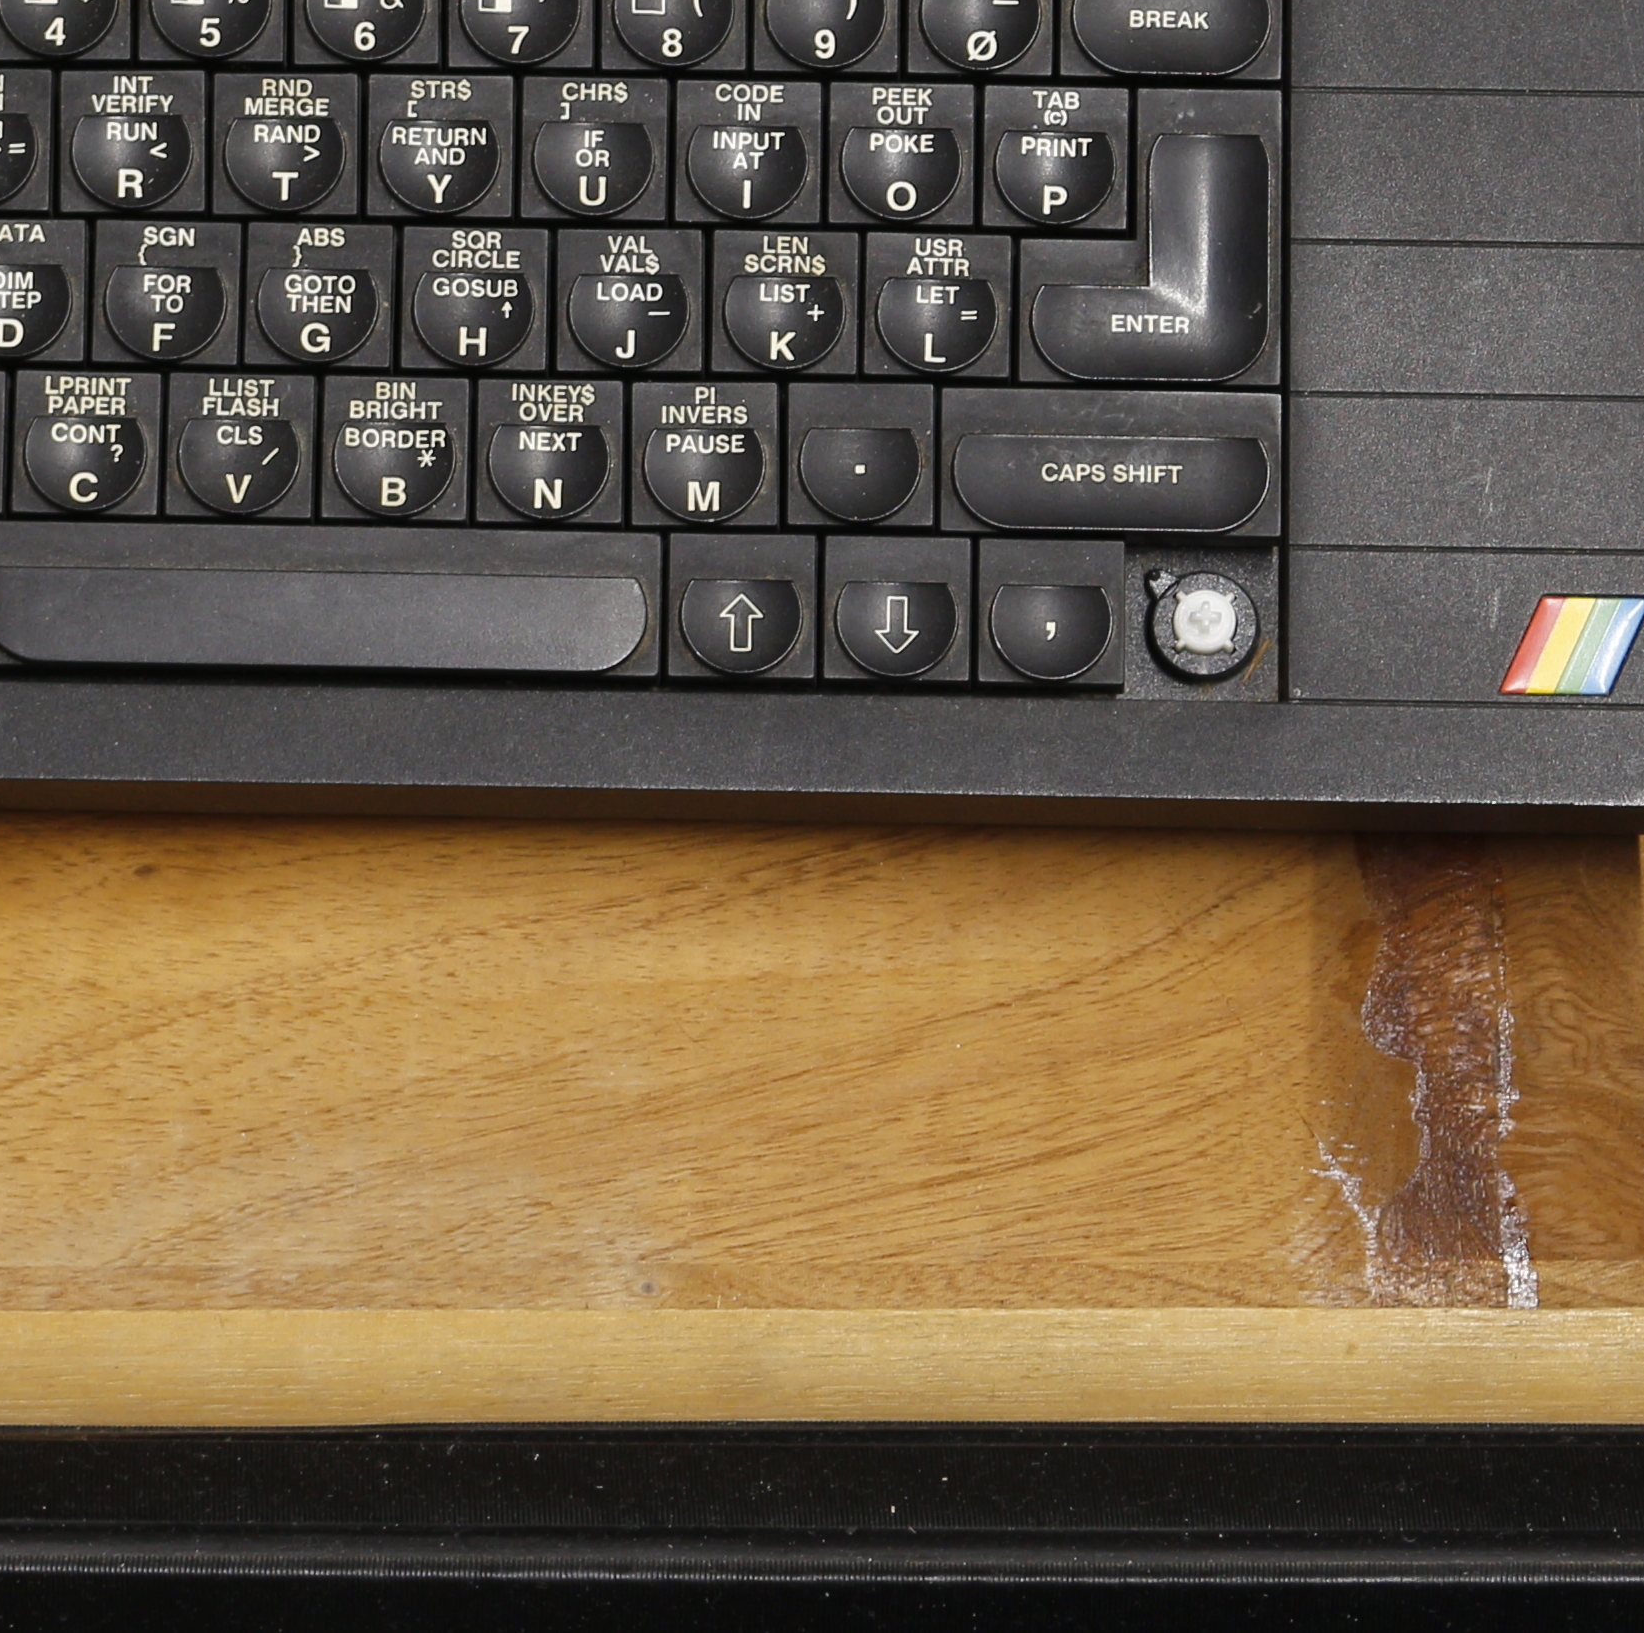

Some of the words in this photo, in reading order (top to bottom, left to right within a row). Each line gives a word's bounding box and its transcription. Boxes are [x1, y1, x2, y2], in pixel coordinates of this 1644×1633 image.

[1129, 9, 1209, 30] BREAK
[715, 83, 784, 103] CODE
[872, 87, 933, 106] PEEK
[106, 121, 158, 142] RUN
[253, 123, 321, 144] RAND
[392, 126, 487, 147] RETURN
[712, 130, 786, 153] INPUT
[869, 132, 934, 156] POKE
[1021, 136, 1093, 160] PRINT
[915, 237, 963, 258] USR
[284, 273, 356, 295] GOTO
[596, 281, 663, 303] LOAD
[1111, 314, 1190, 335] ENTER
[44, 375, 132, 396] LPRINT
[48, 395, 126, 416] PAPER
[349, 400, 443, 420] BRIGHT
[51, 422, 121, 444] CONT
[345, 427, 446, 450] BORDER
[518, 430, 583, 452] NEXT
[666, 433, 745, 454] PAUSE
[1041, 462, 1106, 483] CAPS
[1112, 464, 1183, 484] SHIFT
